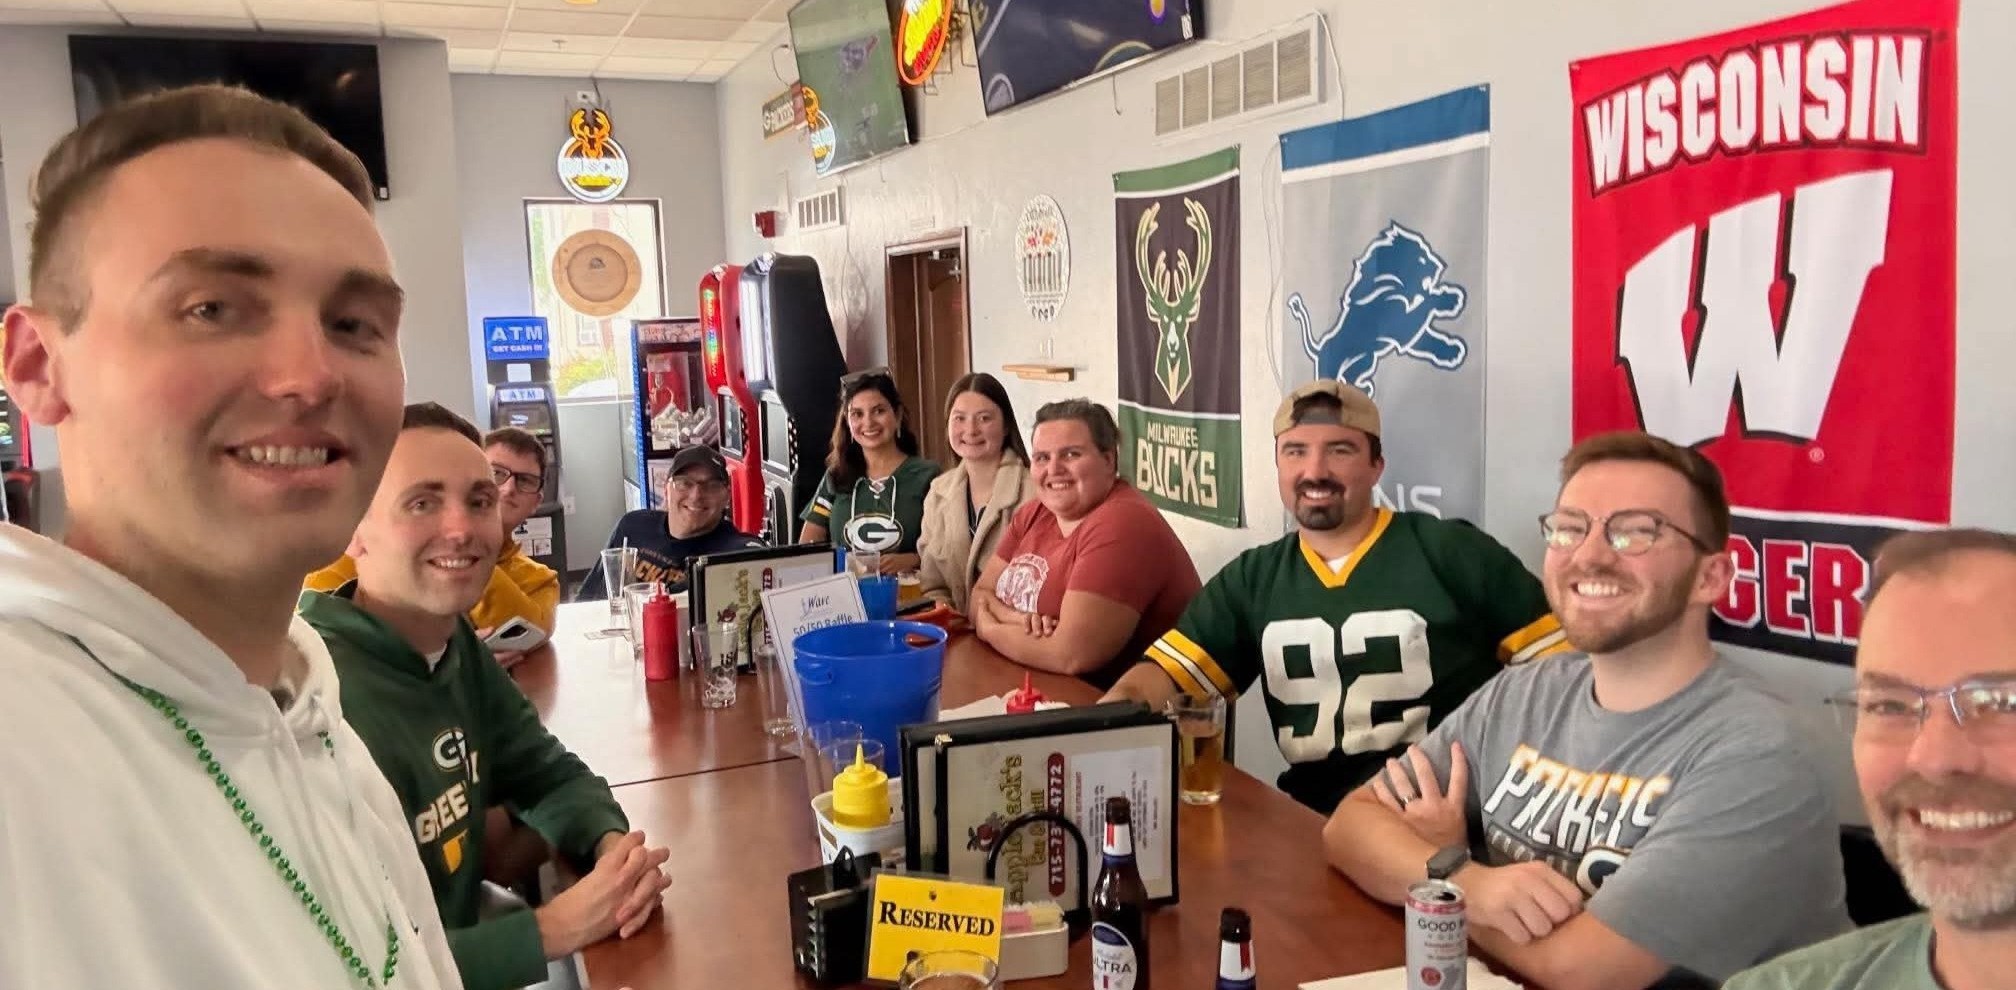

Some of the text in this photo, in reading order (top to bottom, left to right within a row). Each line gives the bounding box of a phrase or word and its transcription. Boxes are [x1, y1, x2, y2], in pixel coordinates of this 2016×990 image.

[1585, 34, 1924, 189] WISCONSIN
[1618, 168, 1894, 448] W
[491, 325, 543, 341] ATM
[492, 345, 509, 353] GET
[510, 344, 532, 352] CASH
[511, 390, 536, 400] ATM
[1147, 421, 1199, 448] MILWAUKEE
[1136, 438, 1218, 508] BUCKS
[845, 514, 903, 552] G
[1261, 608, 1433, 765] 92
[1050, 763, 1062, 885] 715-73-4772
[878, 901, 995, 937] RESERVED
[1417, 918, 1457, 933] GOOD
